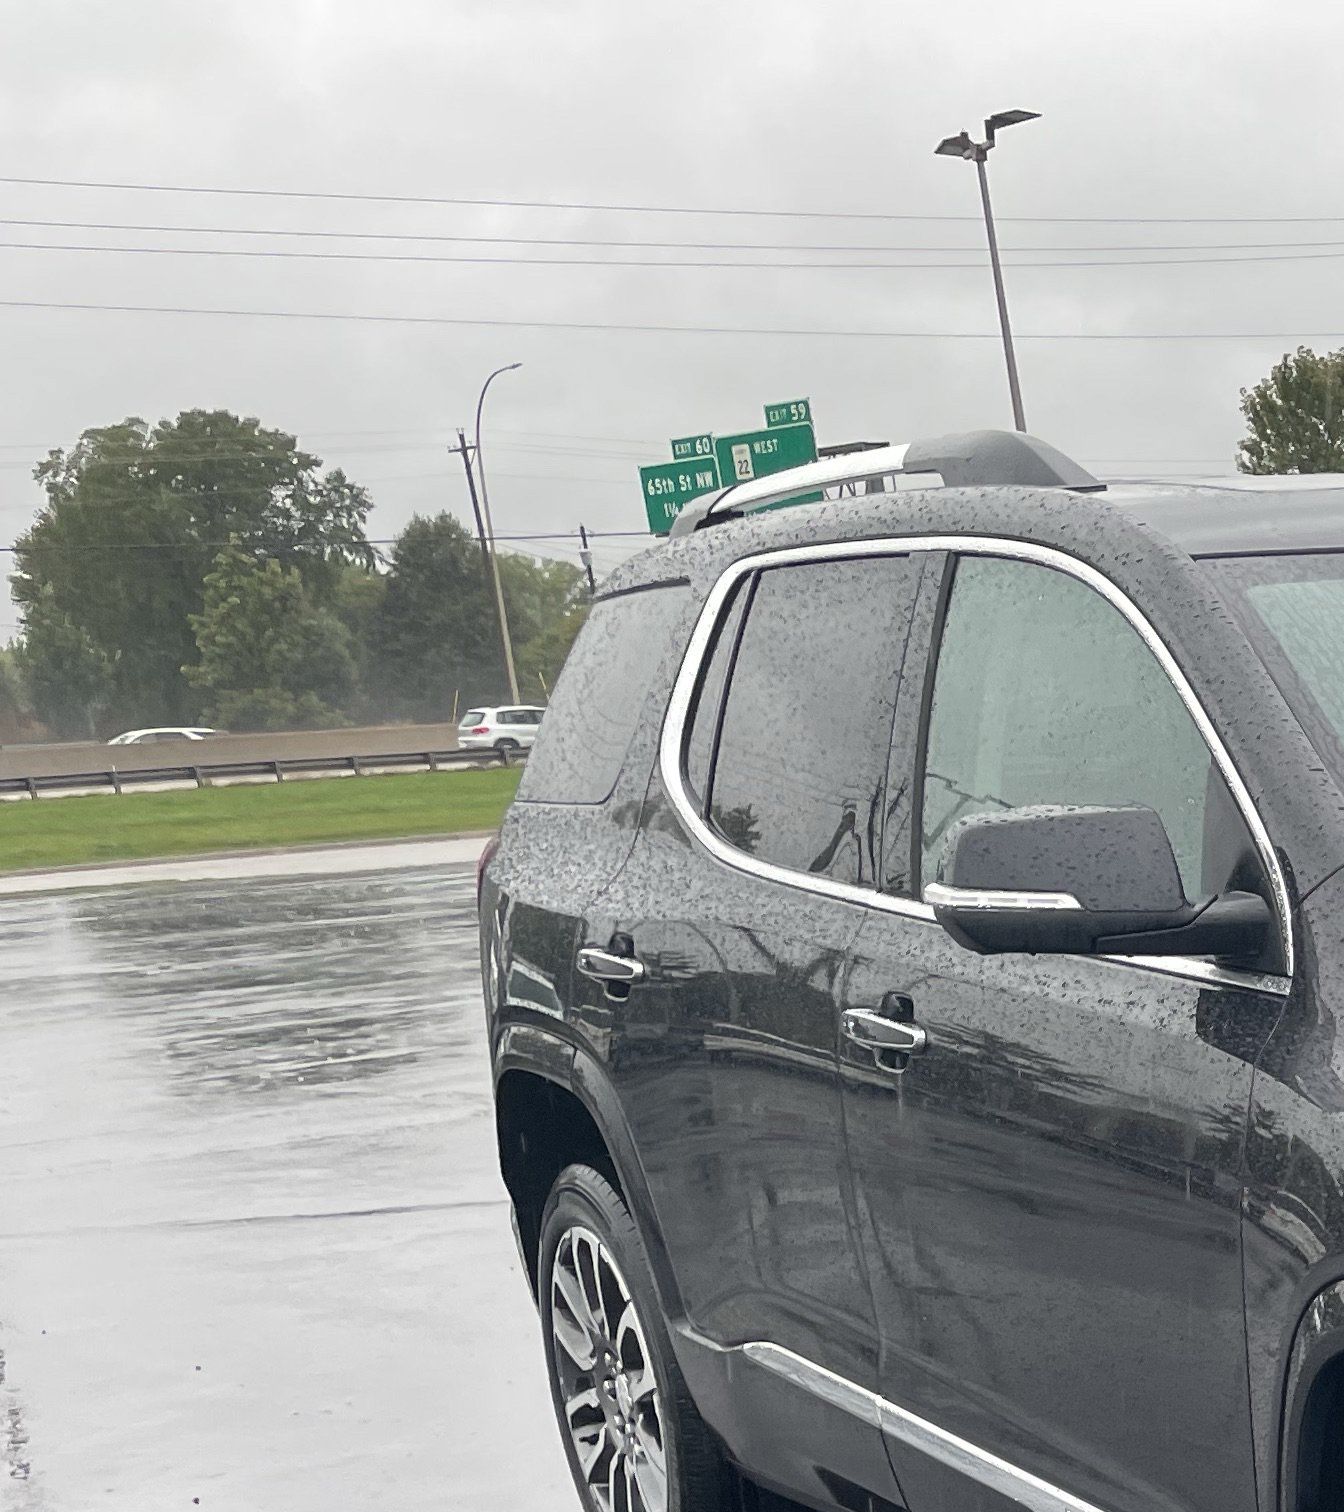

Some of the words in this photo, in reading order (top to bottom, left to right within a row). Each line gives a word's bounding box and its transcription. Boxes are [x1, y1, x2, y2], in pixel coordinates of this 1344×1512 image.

[790, 403, 807, 421] 59
[695, 437, 711, 454] 60
[753, 439, 778, 454] WEST
[738, 459, 751, 476] 22
[647, 477, 675, 496] 65th
[678, 473, 692, 491] St
[696, 471, 714, 489] NW
